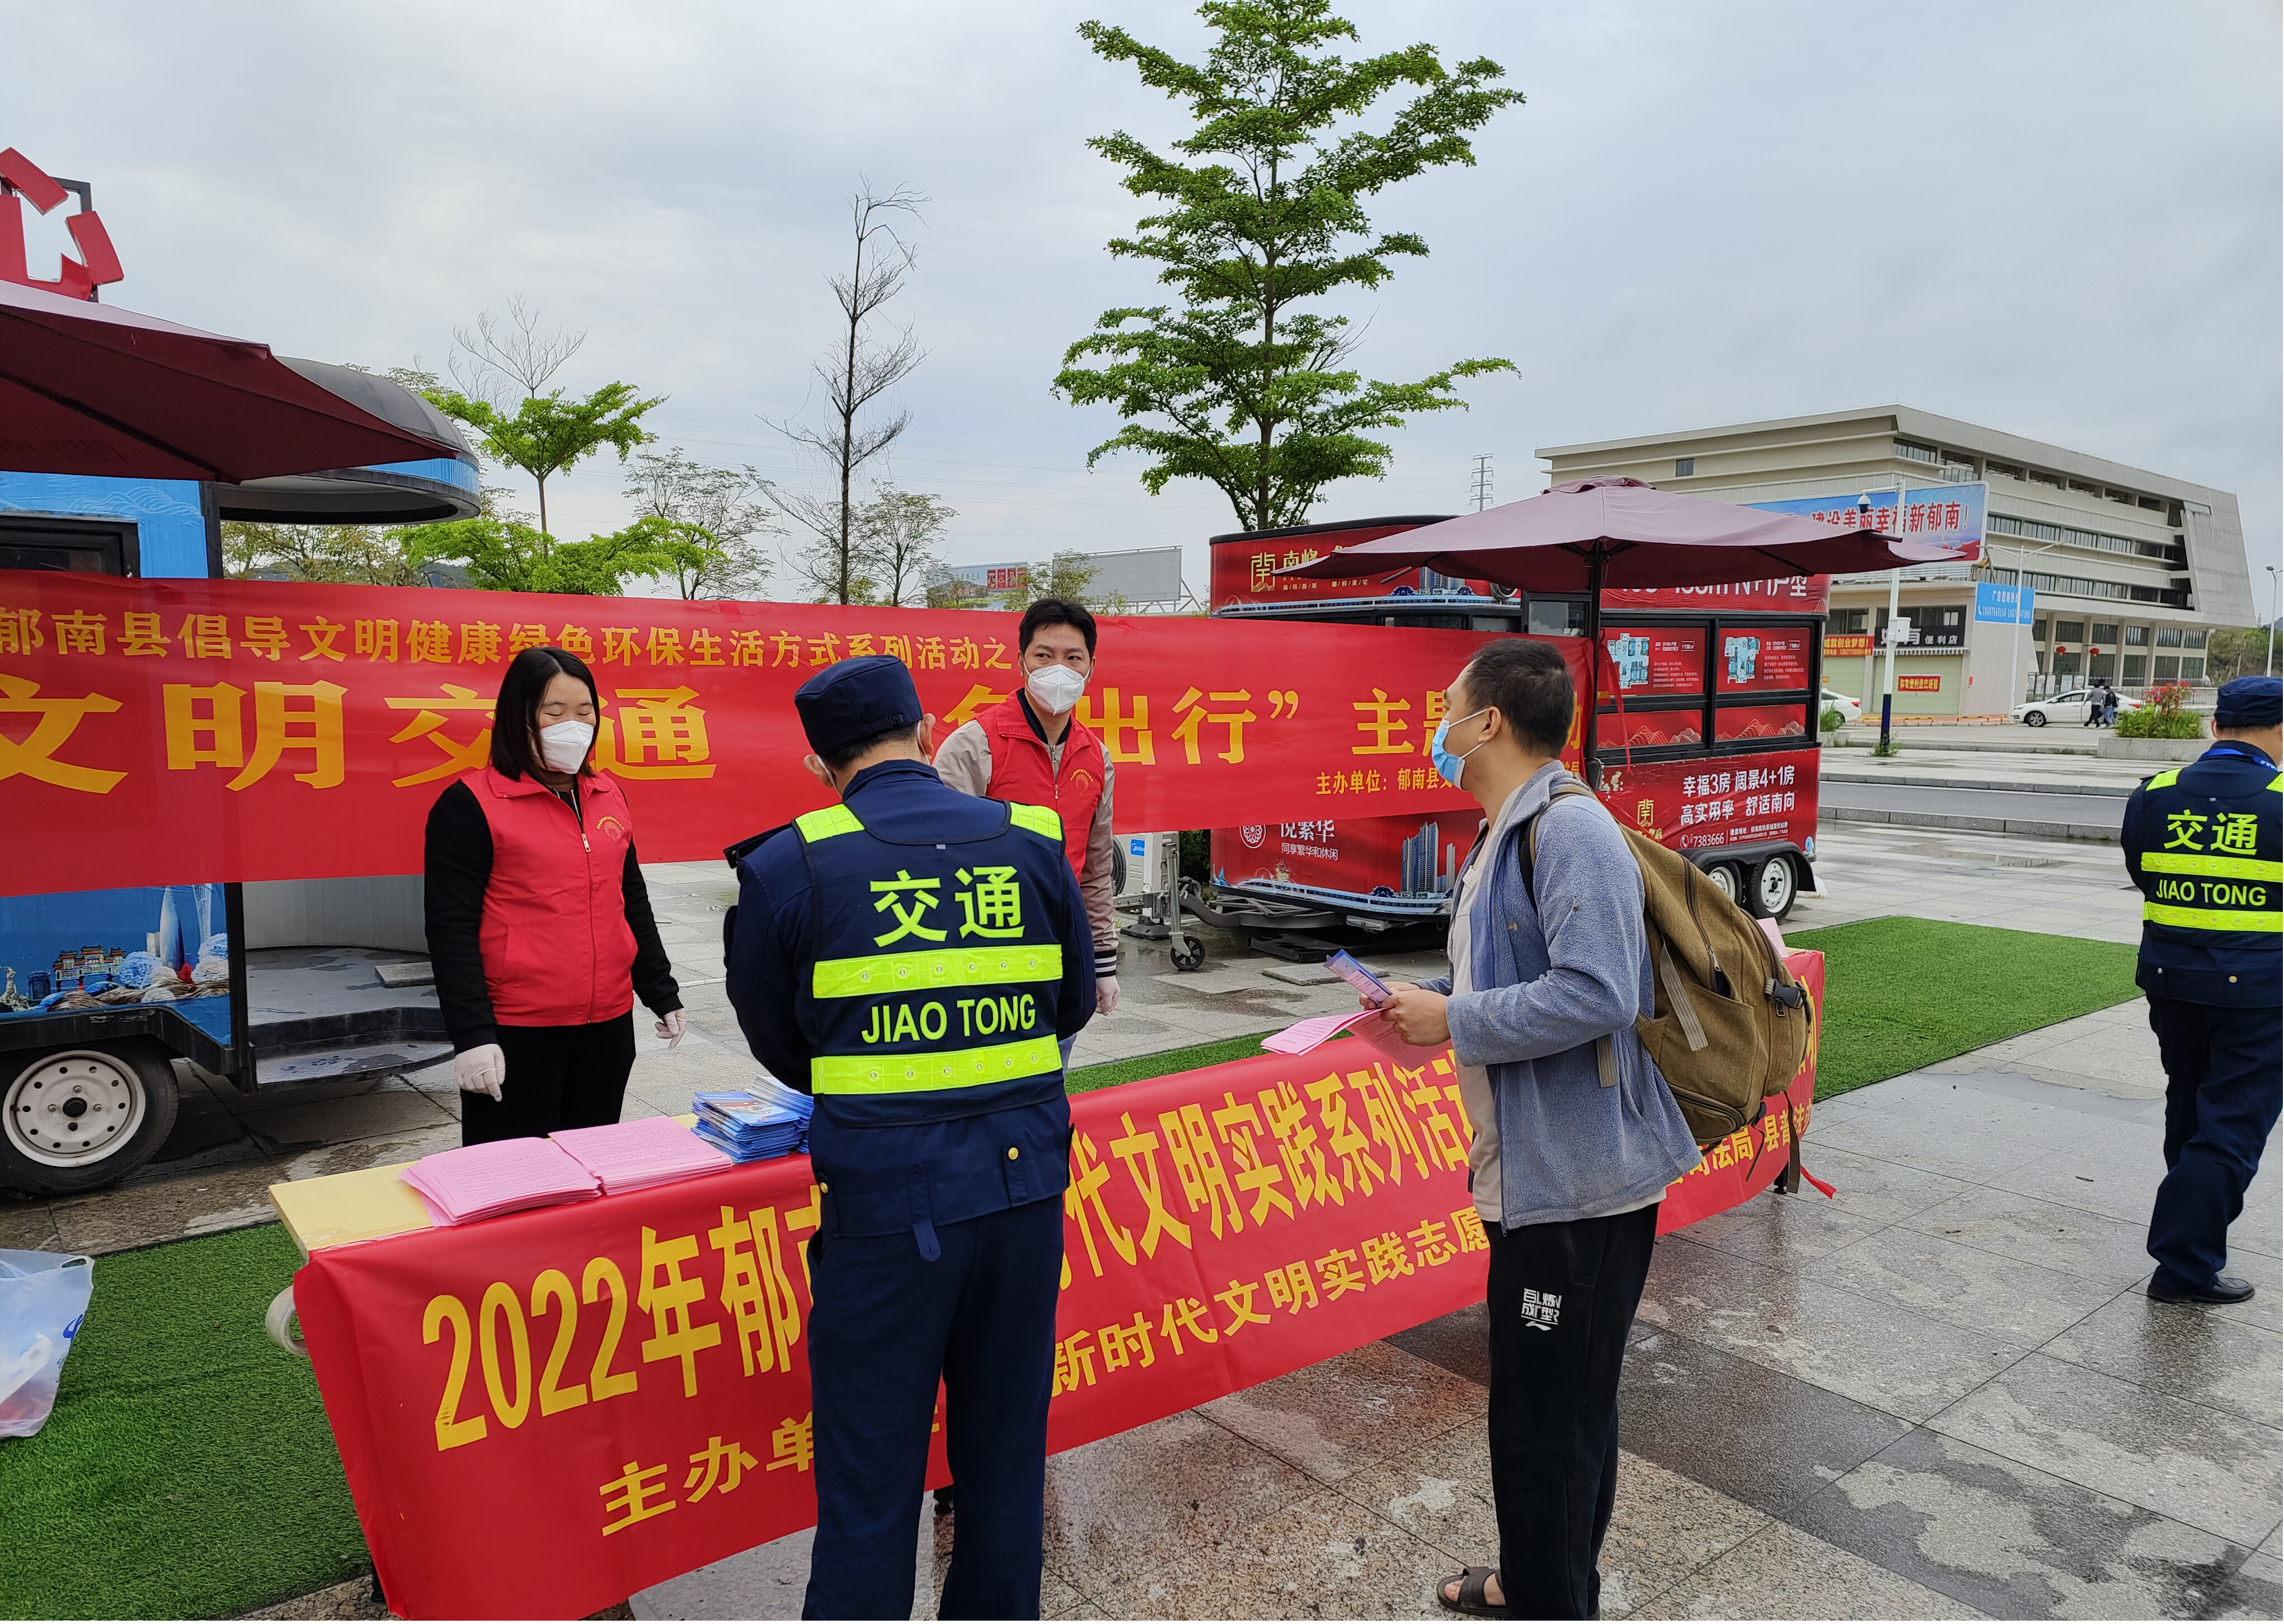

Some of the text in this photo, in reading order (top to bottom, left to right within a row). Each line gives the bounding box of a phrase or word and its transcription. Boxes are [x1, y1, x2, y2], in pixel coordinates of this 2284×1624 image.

[1683, 765, 1796, 798] 幸福3房 阔景4+1房
[1680, 791, 1796, 826] 高实用率 舒适南向
[1694, 832, 1725, 848] 7383666
[2163, 809, 2258, 855] 交通
[1281, 842, 1339, 861] 同享繁华和休闲
[870, 865, 1025, 948] 交通
[2156, 879, 2267, 907] JIAO TONG
[861, 994, 1036, 1044] JIAO TONG
